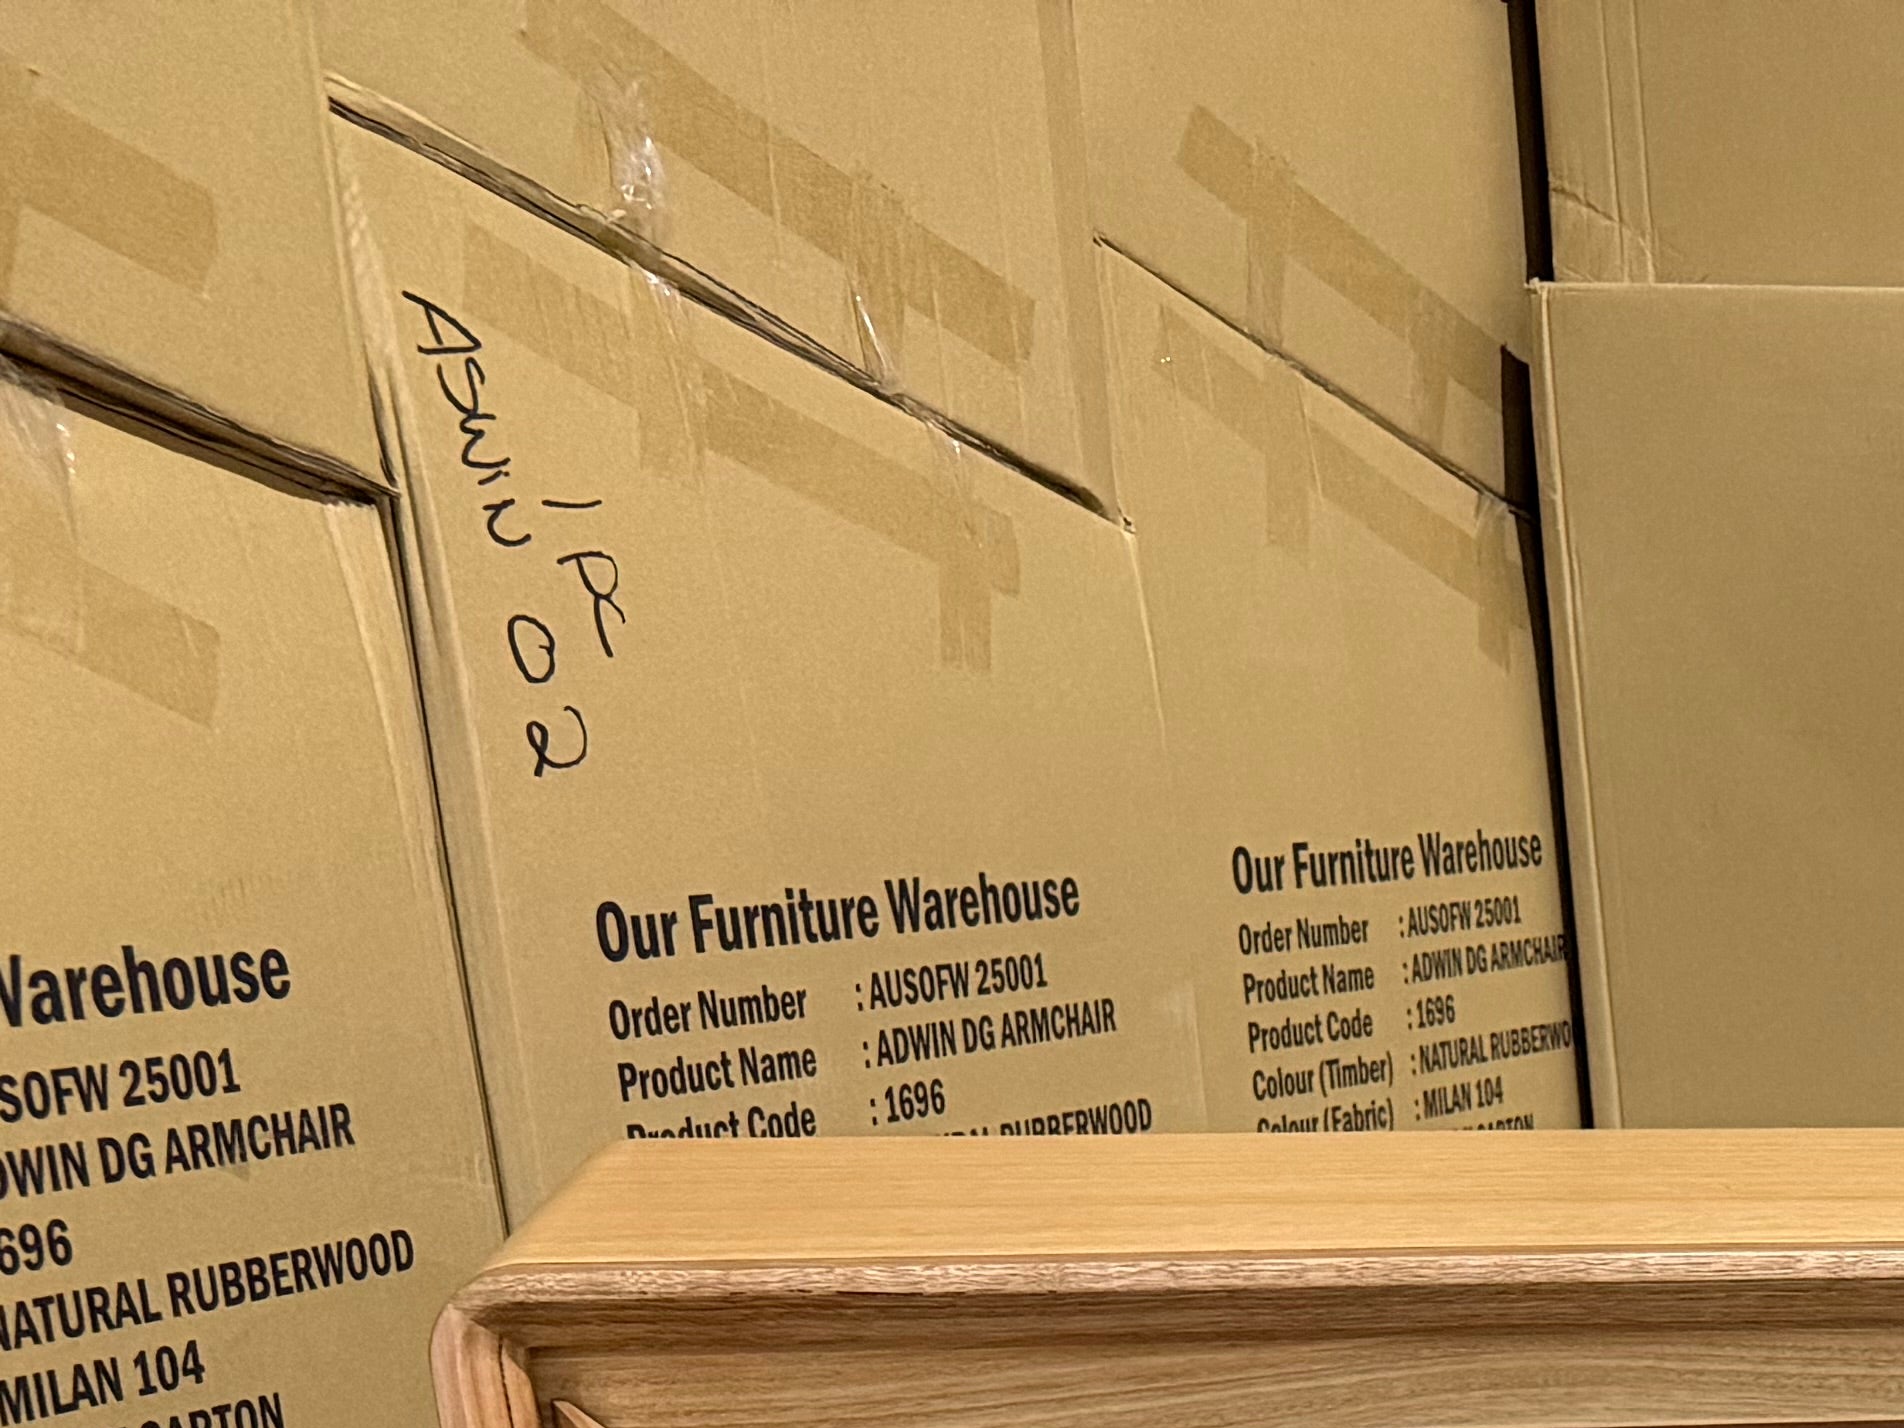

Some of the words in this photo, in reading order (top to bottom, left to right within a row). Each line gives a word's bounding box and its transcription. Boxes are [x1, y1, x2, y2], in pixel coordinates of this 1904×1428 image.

[1232, 846, 1285, 894] Our
[1292, 838, 1414, 889] Furniture
[1417, 829, 1542, 877] Warehouse
[596, 901, 677, 962] Our
[688, 888, 879, 953] Furniture
[884, 872, 1079, 934] Warehouse
[1239, 921, 1292, 955] Order
[1296, 915, 1368, 949] Number
[1408, 901, 1470, 937] AUSOFW
[1475, 896, 1521, 928] 25001
[609, 996, 691, 1040] Order
[698, 985, 806, 1030] Number
[870, 961, 968, 1010] AUSOFW
[975, 953, 1048, 995] 25001
[1243, 966, 1319, 1005] Product
[1322, 964, 1374, 994] Name
[1412, 948, 1462, 983] ADWIN
[1466, 944, 1488, 975] DG
[617, 1051, 735, 1102] Product
[738, 1046, 816, 1086] Name
[877, 1020, 957, 1067] ADWIN
[962, 1015, 996, 1053] DG
[1001, 998, 1116, 1048] ARMCHAIR
[1248, 1014, 1323, 1053] Product
[1327, 1008, 1373, 1041] Code
[1417, 994, 1455, 1028] 1696
[119, 1048, 241, 1107] 25001
[885, 1078, 945, 1123] 1696
[1253, 1067, 1314, 1101] Colour
[1319, 1051, 1393, 1098] (Timber)
[1419, 1035, 1488, 1074] NATURAL
[1423, 1082, 1471, 1119] MILAN
[1476, 1076, 1503, 1108] 104
[97, 1133, 156, 1183] DG
[165, 1103, 355, 1174] ARMCHAIR
[166, 1230, 413, 1317] RUBBERWOOD
[0, 1357, 123, 1427] MILAN
[133, 1340, 205, 1396] 104
